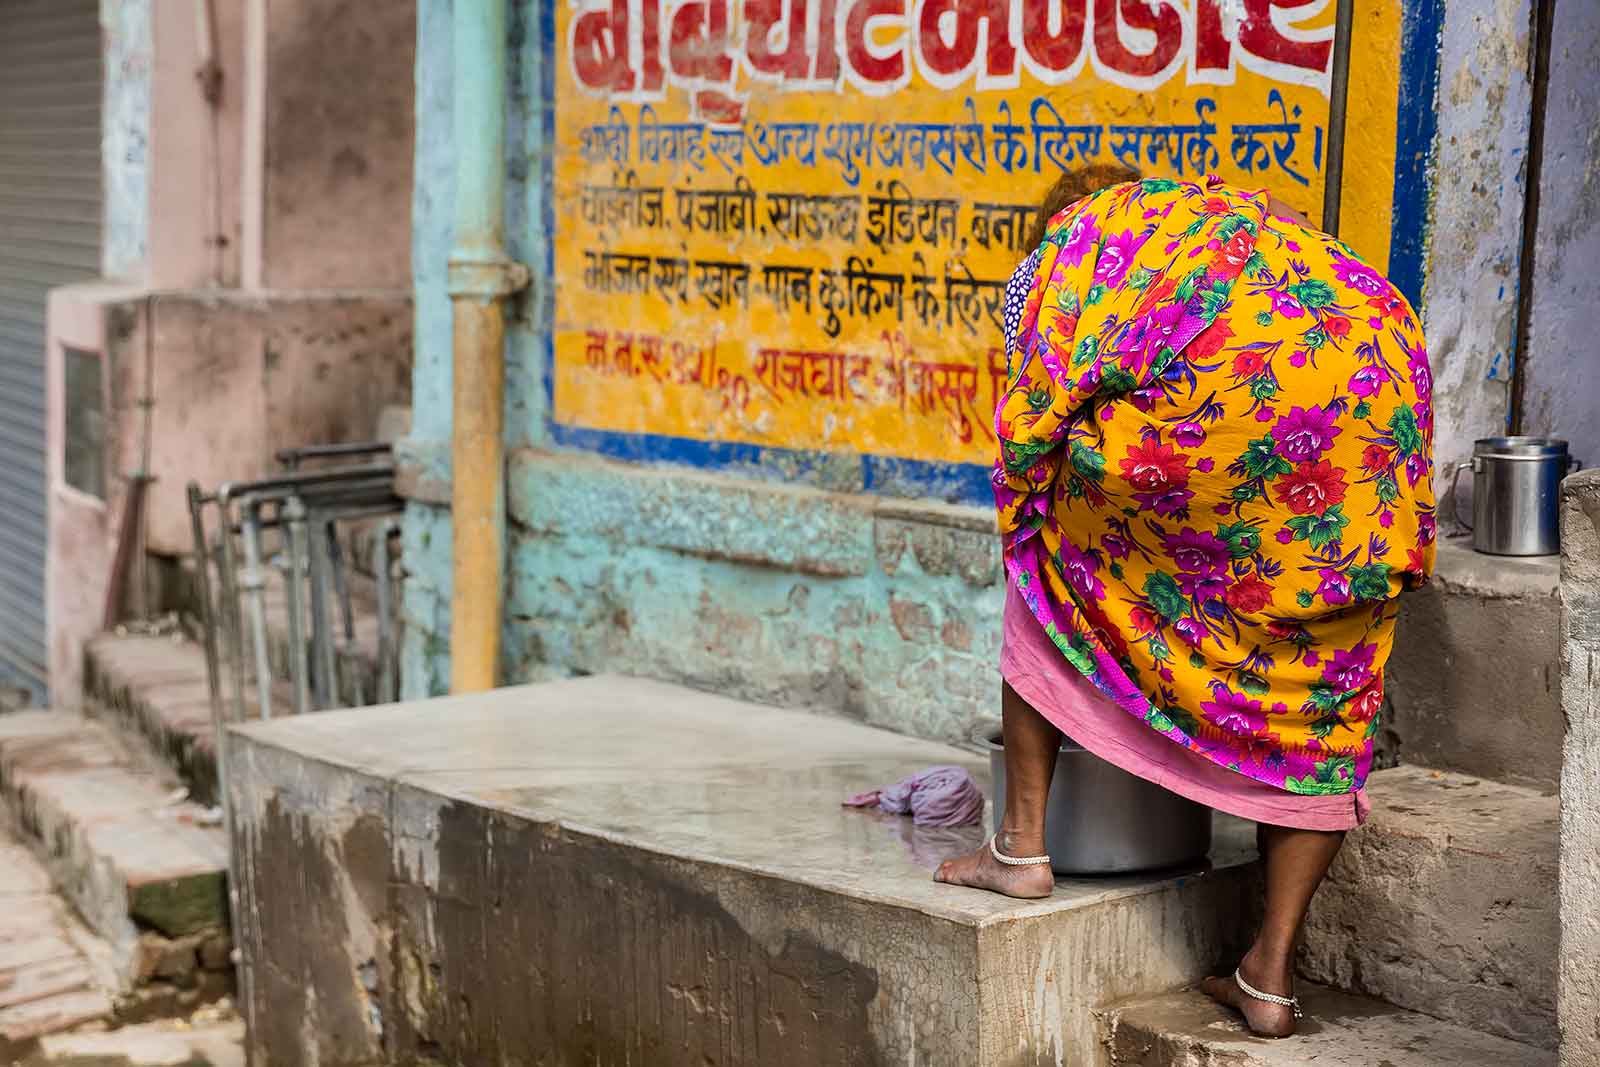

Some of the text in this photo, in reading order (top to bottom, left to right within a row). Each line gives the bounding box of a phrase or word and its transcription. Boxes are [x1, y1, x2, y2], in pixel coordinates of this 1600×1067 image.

[637, 104, 705, 172] विवाह
[749, 123, 820, 167] अन्य
[822, 123, 877, 186] शुभ
[992, 100, 1028, 174] के
[1029, 97, 1103, 174] लिए
[1109, 97, 1220, 177] सम्पर्क
[911, 252, 940, 328] के
